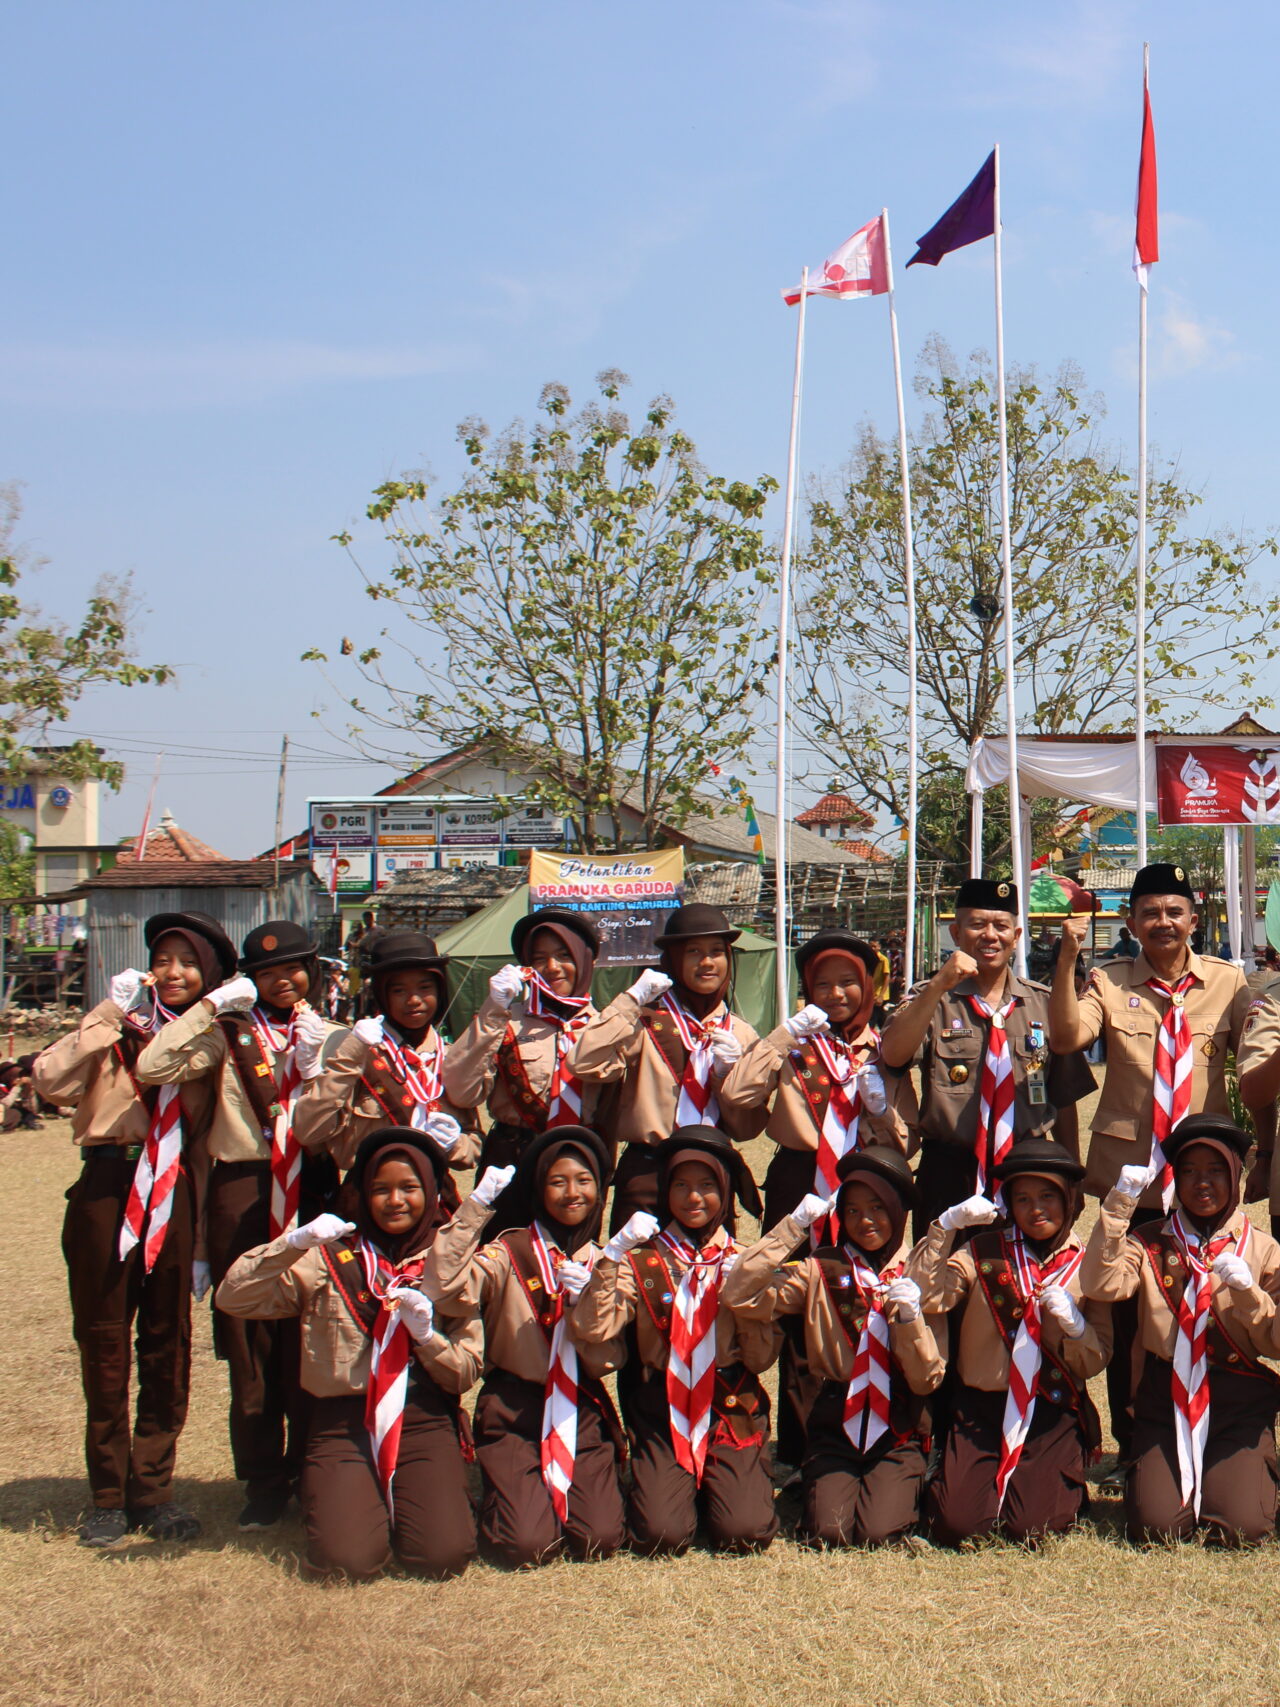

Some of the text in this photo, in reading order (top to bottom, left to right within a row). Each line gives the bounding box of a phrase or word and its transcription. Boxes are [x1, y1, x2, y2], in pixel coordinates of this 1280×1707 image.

[340, 816, 366, 826] PGRI
[559, 859, 653, 878] Pelantikan
[537, 881, 676, 898] PRAMUKA GARUDA
[580, 901, 626, 912] RANTING
[626, 899, 681, 911] WARUREJA
